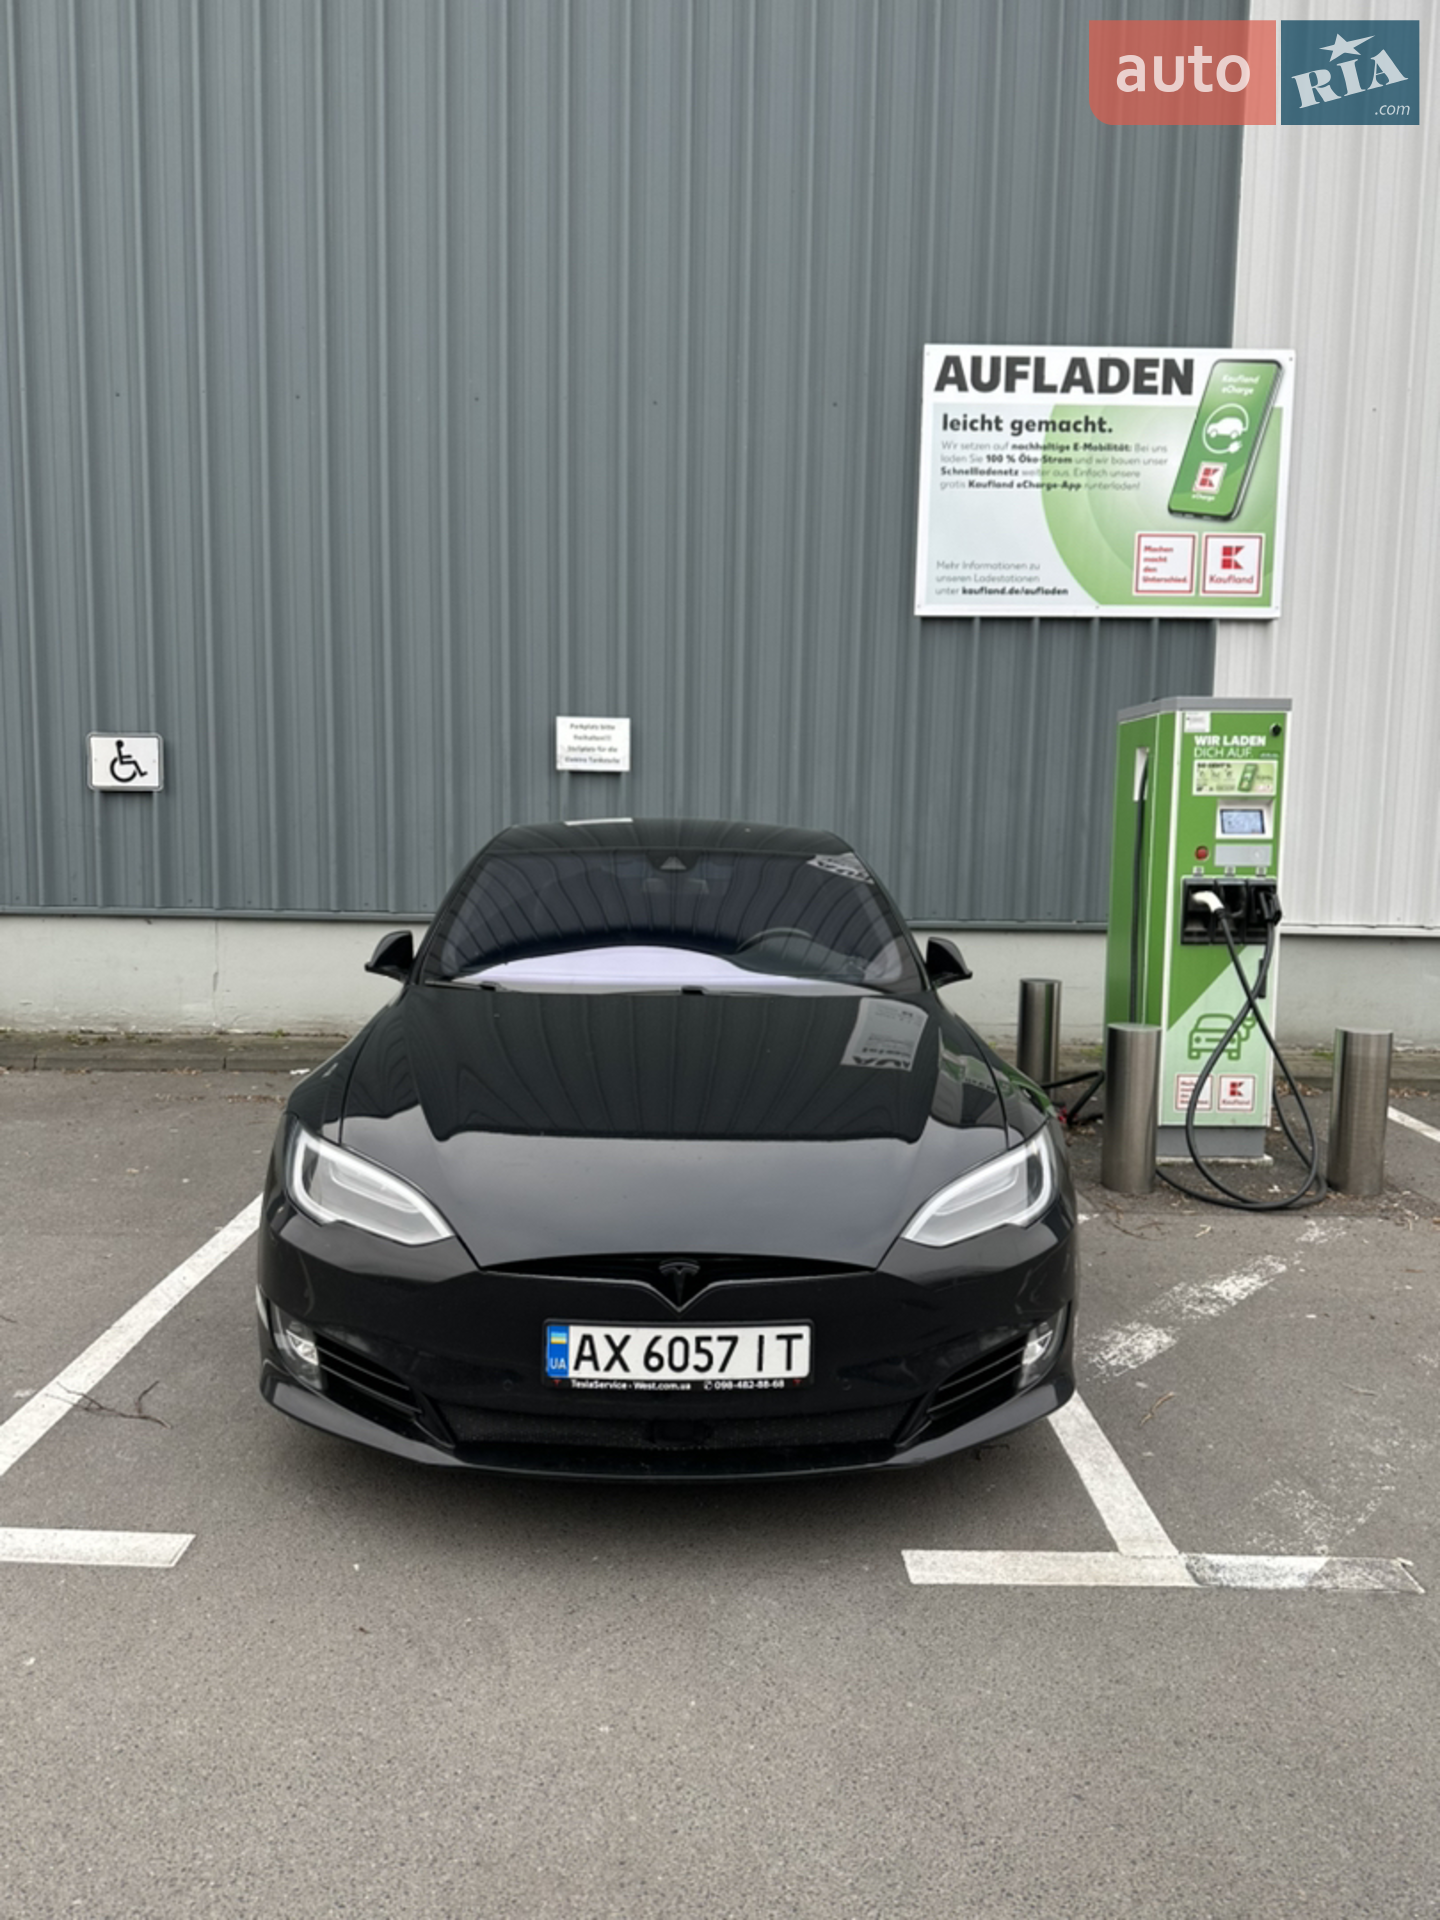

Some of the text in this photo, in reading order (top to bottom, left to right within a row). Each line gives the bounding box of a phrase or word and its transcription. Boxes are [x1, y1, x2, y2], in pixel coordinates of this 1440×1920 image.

[934, 355, 1195, 396] AUFLADEN
[1221, 374, 1260, 384] Kaufland
[1221, 385, 1254, 396] eCharge
[942, 413, 1113, 436] leicht gemacht.
[941, 441, 958, 450] Wir
[960, 442, 991, 450] setzen
[993, 441, 1009, 451] auf
[1011, 442, 1070, 453] nachhaltige
[1134, 443, 1149, 453] Bei
[1152, 446, 1168, 454] uns
[940, 453, 1168, 466] laden Sie 100 % Öko-Strom und wir bauen unser
[1022, 468, 1050, 477] weiter
[1073, 468, 1108, 478] Einfach
[1110, 470, 1140, 478] unsere
[940, 481, 966, 492] gratis
[968, 480, 1014, 489] Kaufland
[1016, 480, 1082, 492] eCharge-App
[936, 560, 960, 570] Mehr
[962, 560, 1028, 570] Informationen
[936, 574, 1040, 583] unseren Ladestationen
[1208, 574, 1254, 584] Kaufland
[935, 586, 1068, 596] unter kaufland.de/aufladen
[1194, 735, 1266, 746] WIR LADEN
[1194, 746, 1224, 758] DICH
[550, 1333, 804, 1373] UA AX 6057 IT
[572, 1379, 627, 1390] TeslaService
